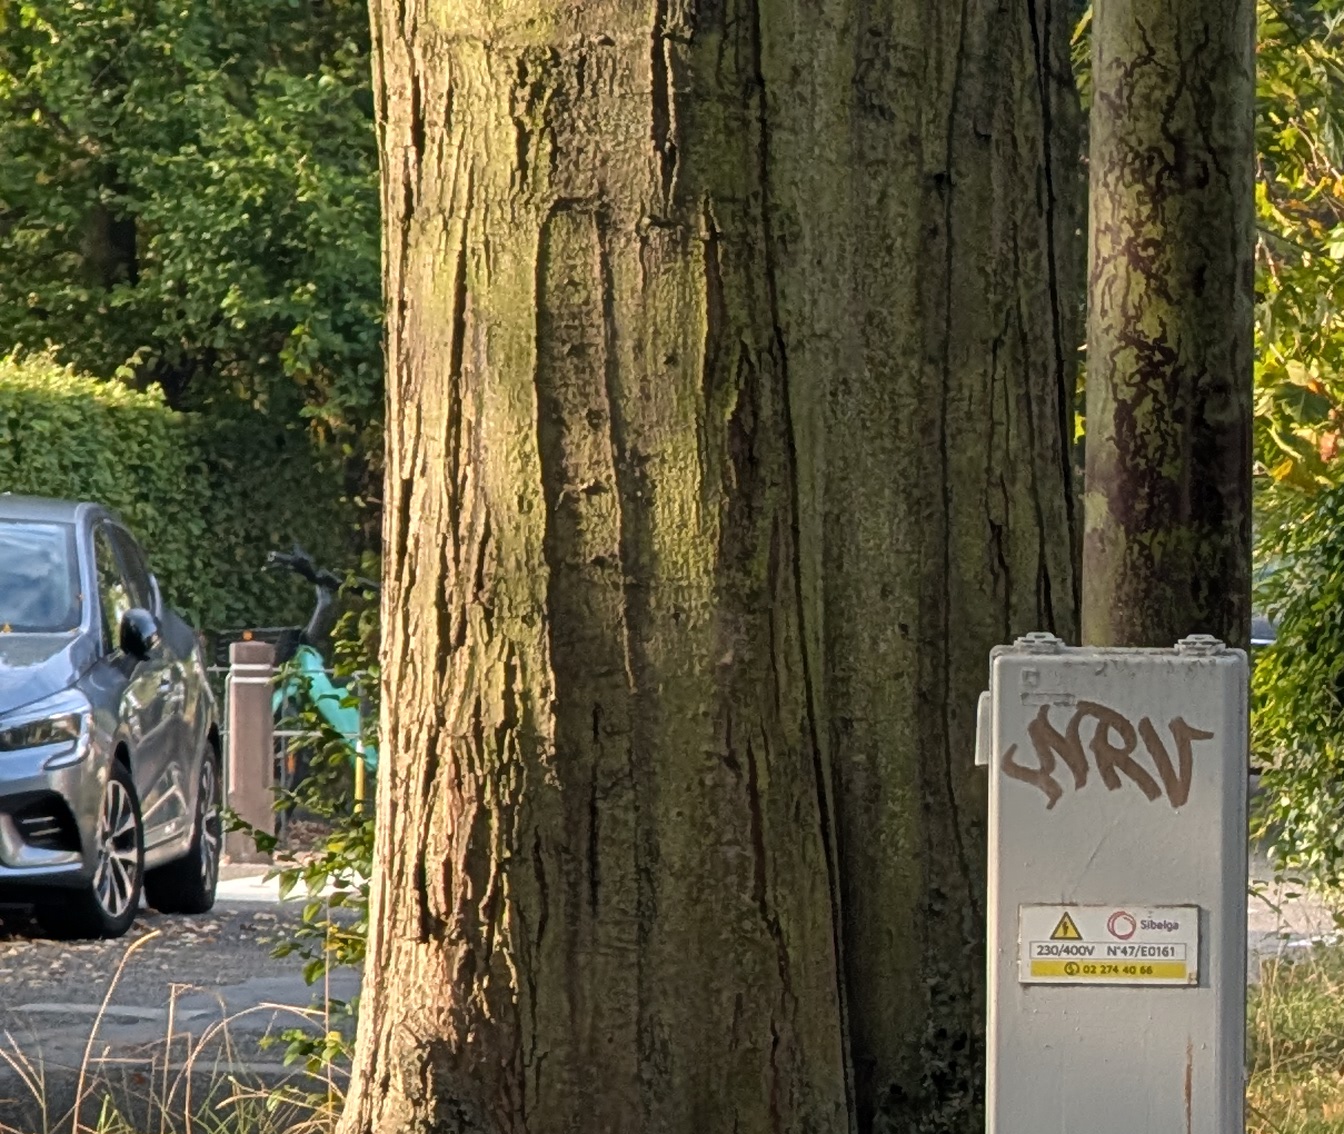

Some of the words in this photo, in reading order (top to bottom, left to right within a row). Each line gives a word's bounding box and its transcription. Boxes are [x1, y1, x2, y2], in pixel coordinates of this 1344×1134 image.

[1140, 919, 1179, 932] Sibelga
[1036, 944, 1095, 957] 230/400V
[1083, 964, 1097, 974] 02
[1100, 964, 1119, 974] 274
[1122, 965, 1136, 975] 40
